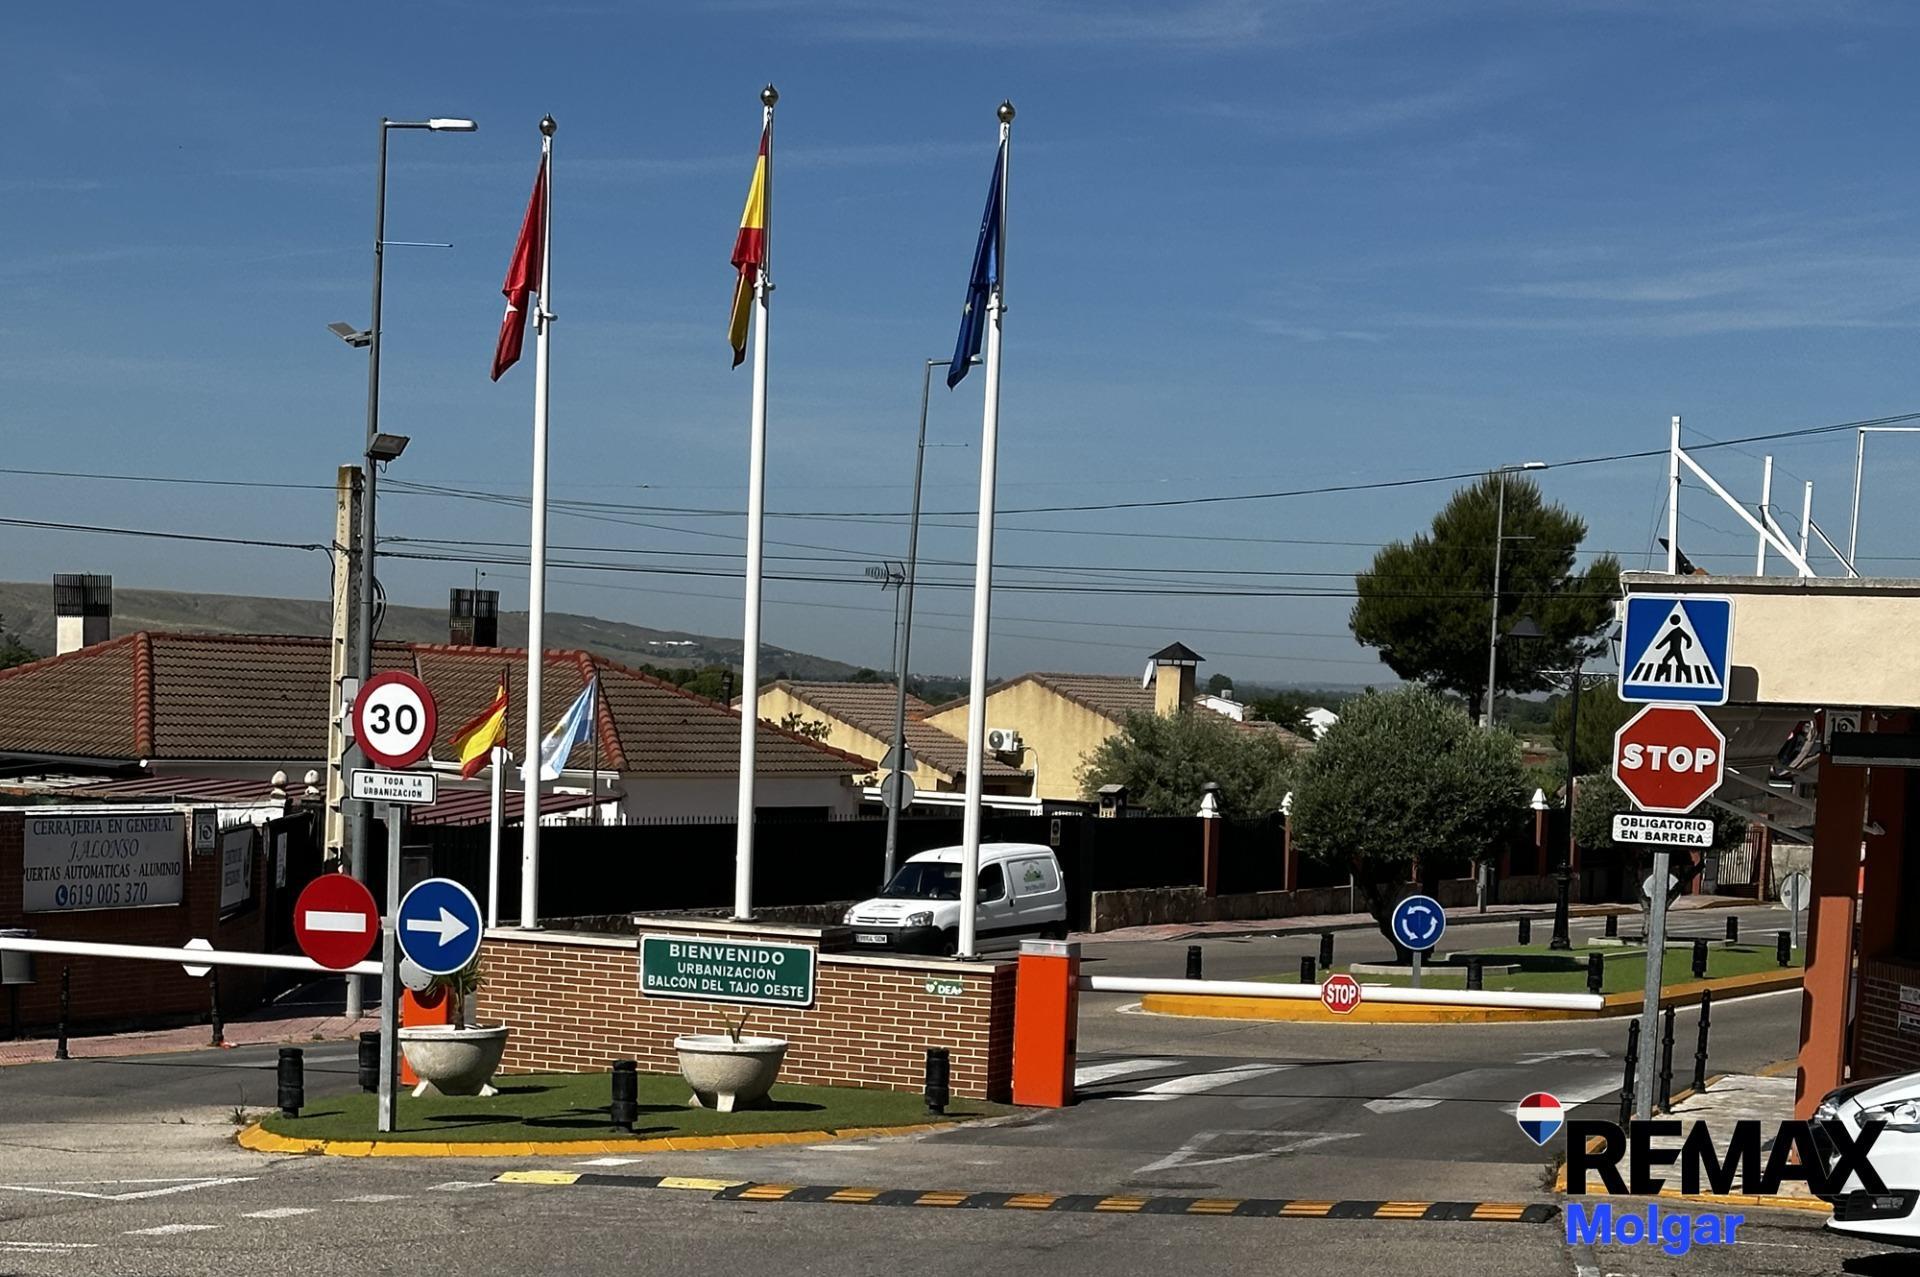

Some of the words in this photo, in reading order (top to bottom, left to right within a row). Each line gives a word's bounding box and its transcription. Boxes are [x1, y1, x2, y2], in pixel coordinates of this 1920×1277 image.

[370, 703, 417, 735] 30
[1620, 743, 1716, 773] STOP
[363, 775, 374, 784] EN
[383, 776, 404, 786] TODA
[412, 778, 423, 787] LA
[363, 787, 423, 798] URBANIZACION
[33, 819, 102, 837] CERRAJERIA
[108, 819, 123, 833] EN
[127, 818, 174, 834] GENERAL
[1620, 817, 1707, 831] OBLIGATORIO
[1621, 830, 1638, 840] EN
[1645, 831, 1704, 844] BARRERA
[24, 866, 61, 882] UERTAS
[64, 863, 130, 880] AUTOMATICAS
[139, 861, 180, 878] ALUMINIO
[69, 884, 93, 906] 619
[98, 883, 120, 904] 005
[125, 881, 148, 903] 370
[669, 943, 785, 965] BIENVENIDO
[677, 961, 776, 981] URBANIZACIÓN
[647, 974, 697, 990] BALCÓN
[701, 979, 724, 992] DEL
[729, 981, 759, 994] TAJO
[764, 983, 804, 998] OESTE
[1326, 983, 1357, 1005] STOP
